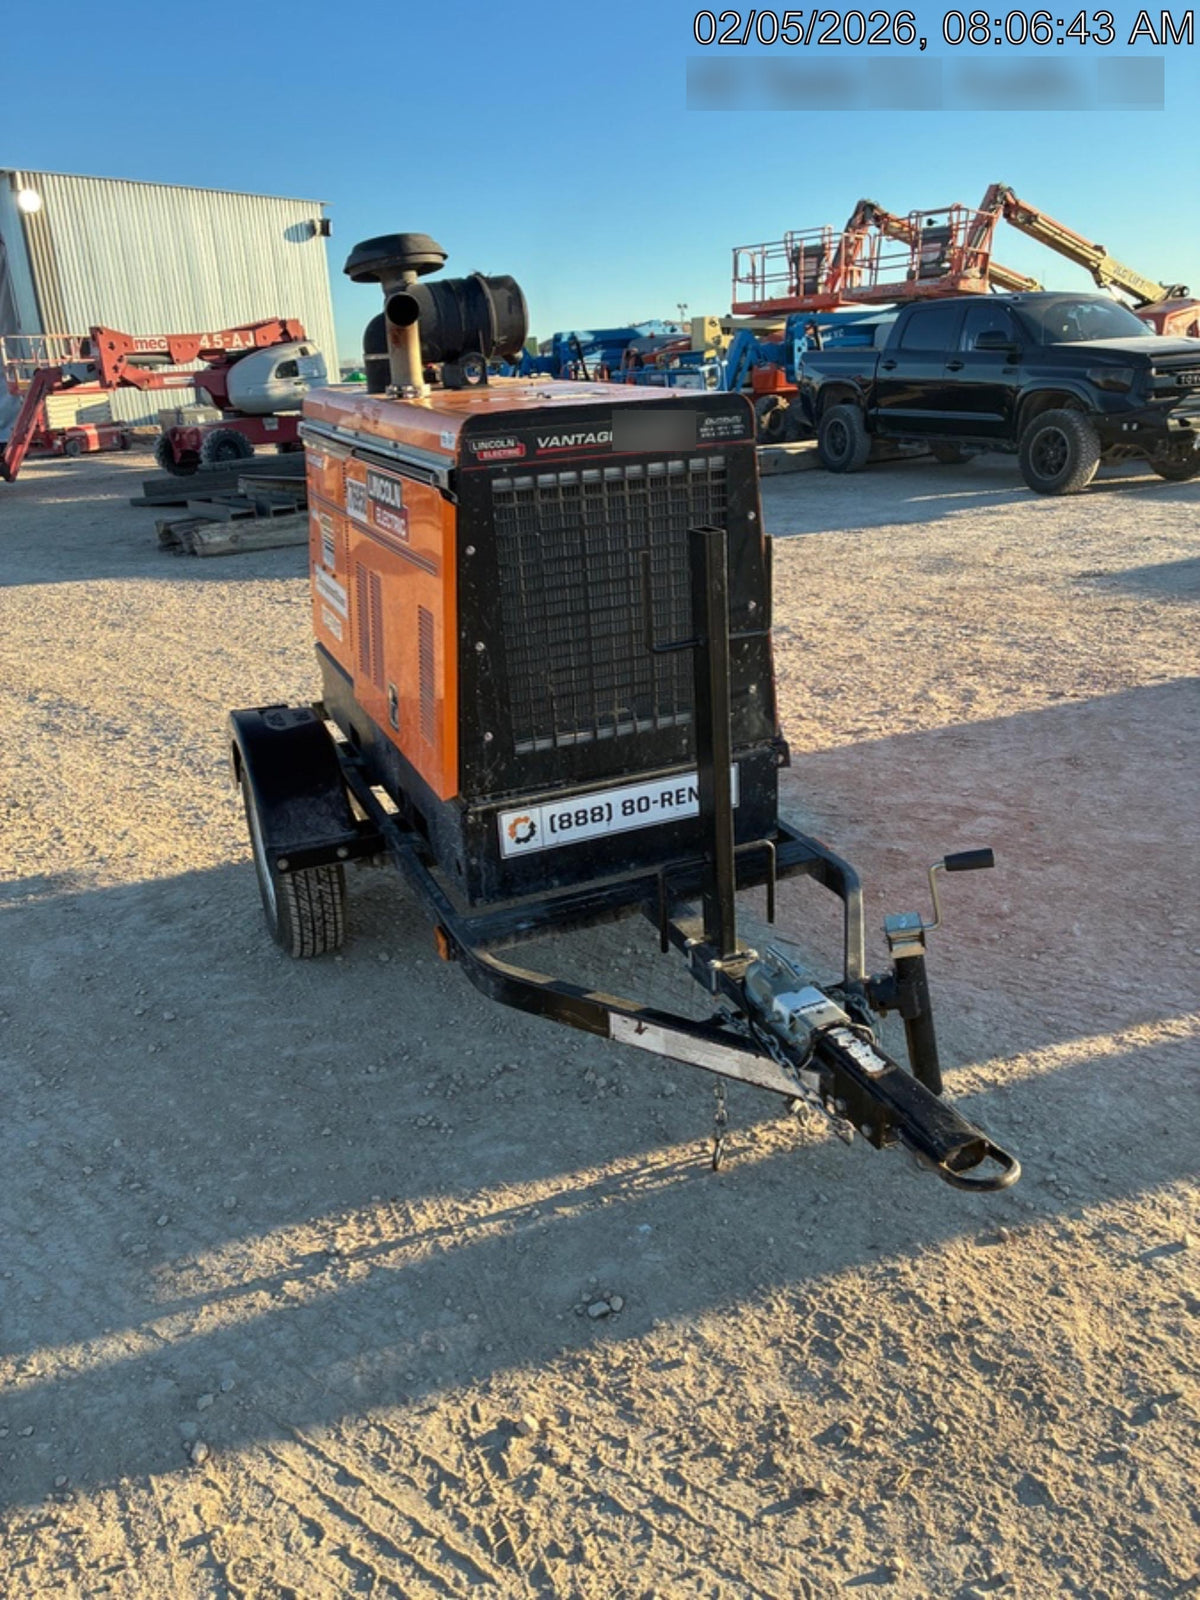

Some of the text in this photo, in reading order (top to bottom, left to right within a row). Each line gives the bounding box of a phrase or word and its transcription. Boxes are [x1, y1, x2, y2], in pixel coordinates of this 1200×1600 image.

[536, 430, 613, 449] VANTAG
[549, 786, 700, 834] (888) 80-REN
